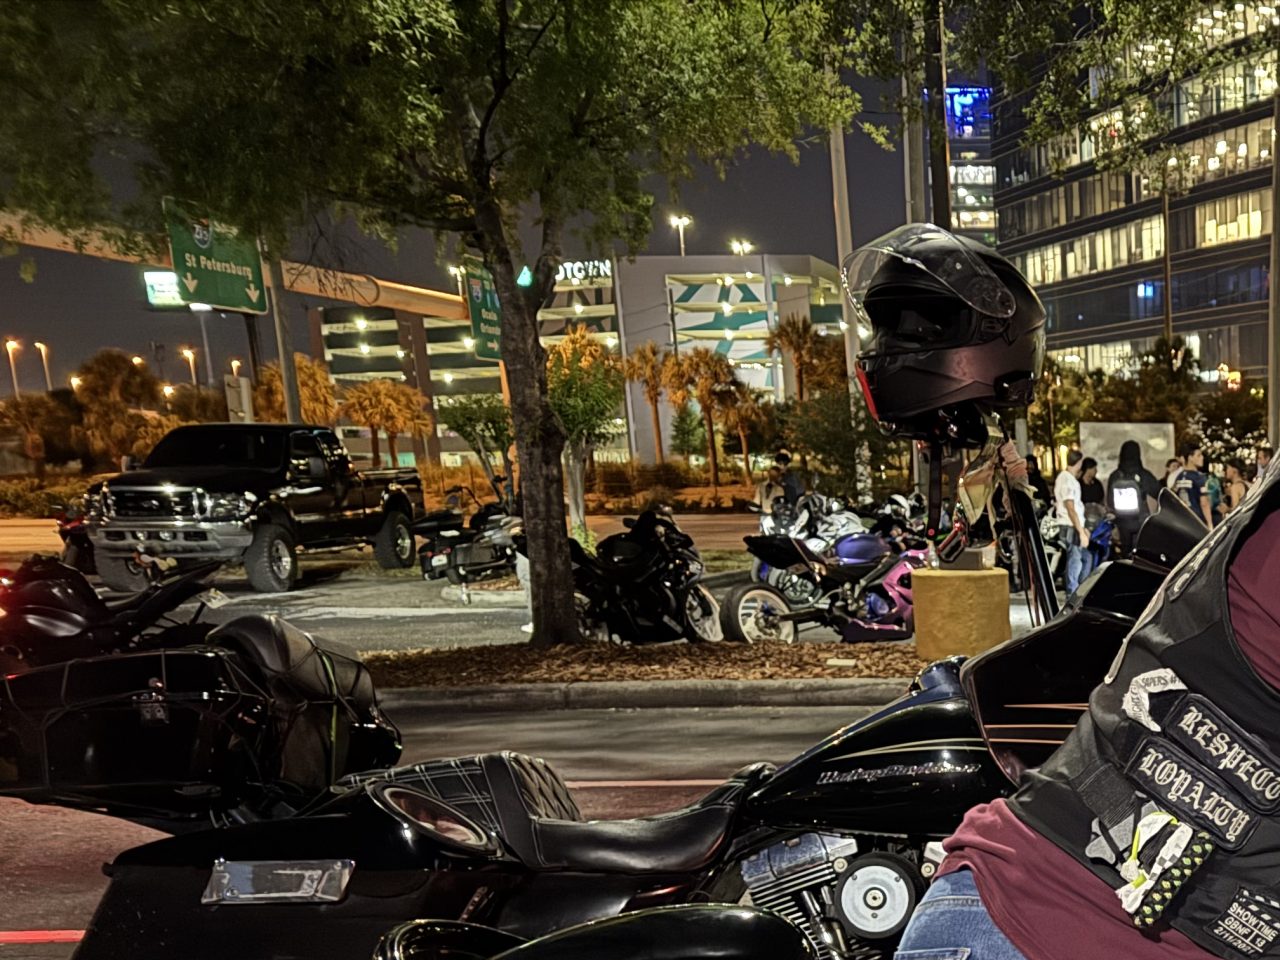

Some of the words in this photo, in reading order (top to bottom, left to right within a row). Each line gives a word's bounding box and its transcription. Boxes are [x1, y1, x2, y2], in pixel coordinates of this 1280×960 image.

[185, 253, 197, 268] St
[200, 255, 252, 281] Petersburg
[1138, 748, 1250, 842] LOYALTY
[1224, 916, 1252, 937] GBNF
[1254, 937, 1267, 948] 13
[1229, 902, 1278, 942] SHOWTIME
